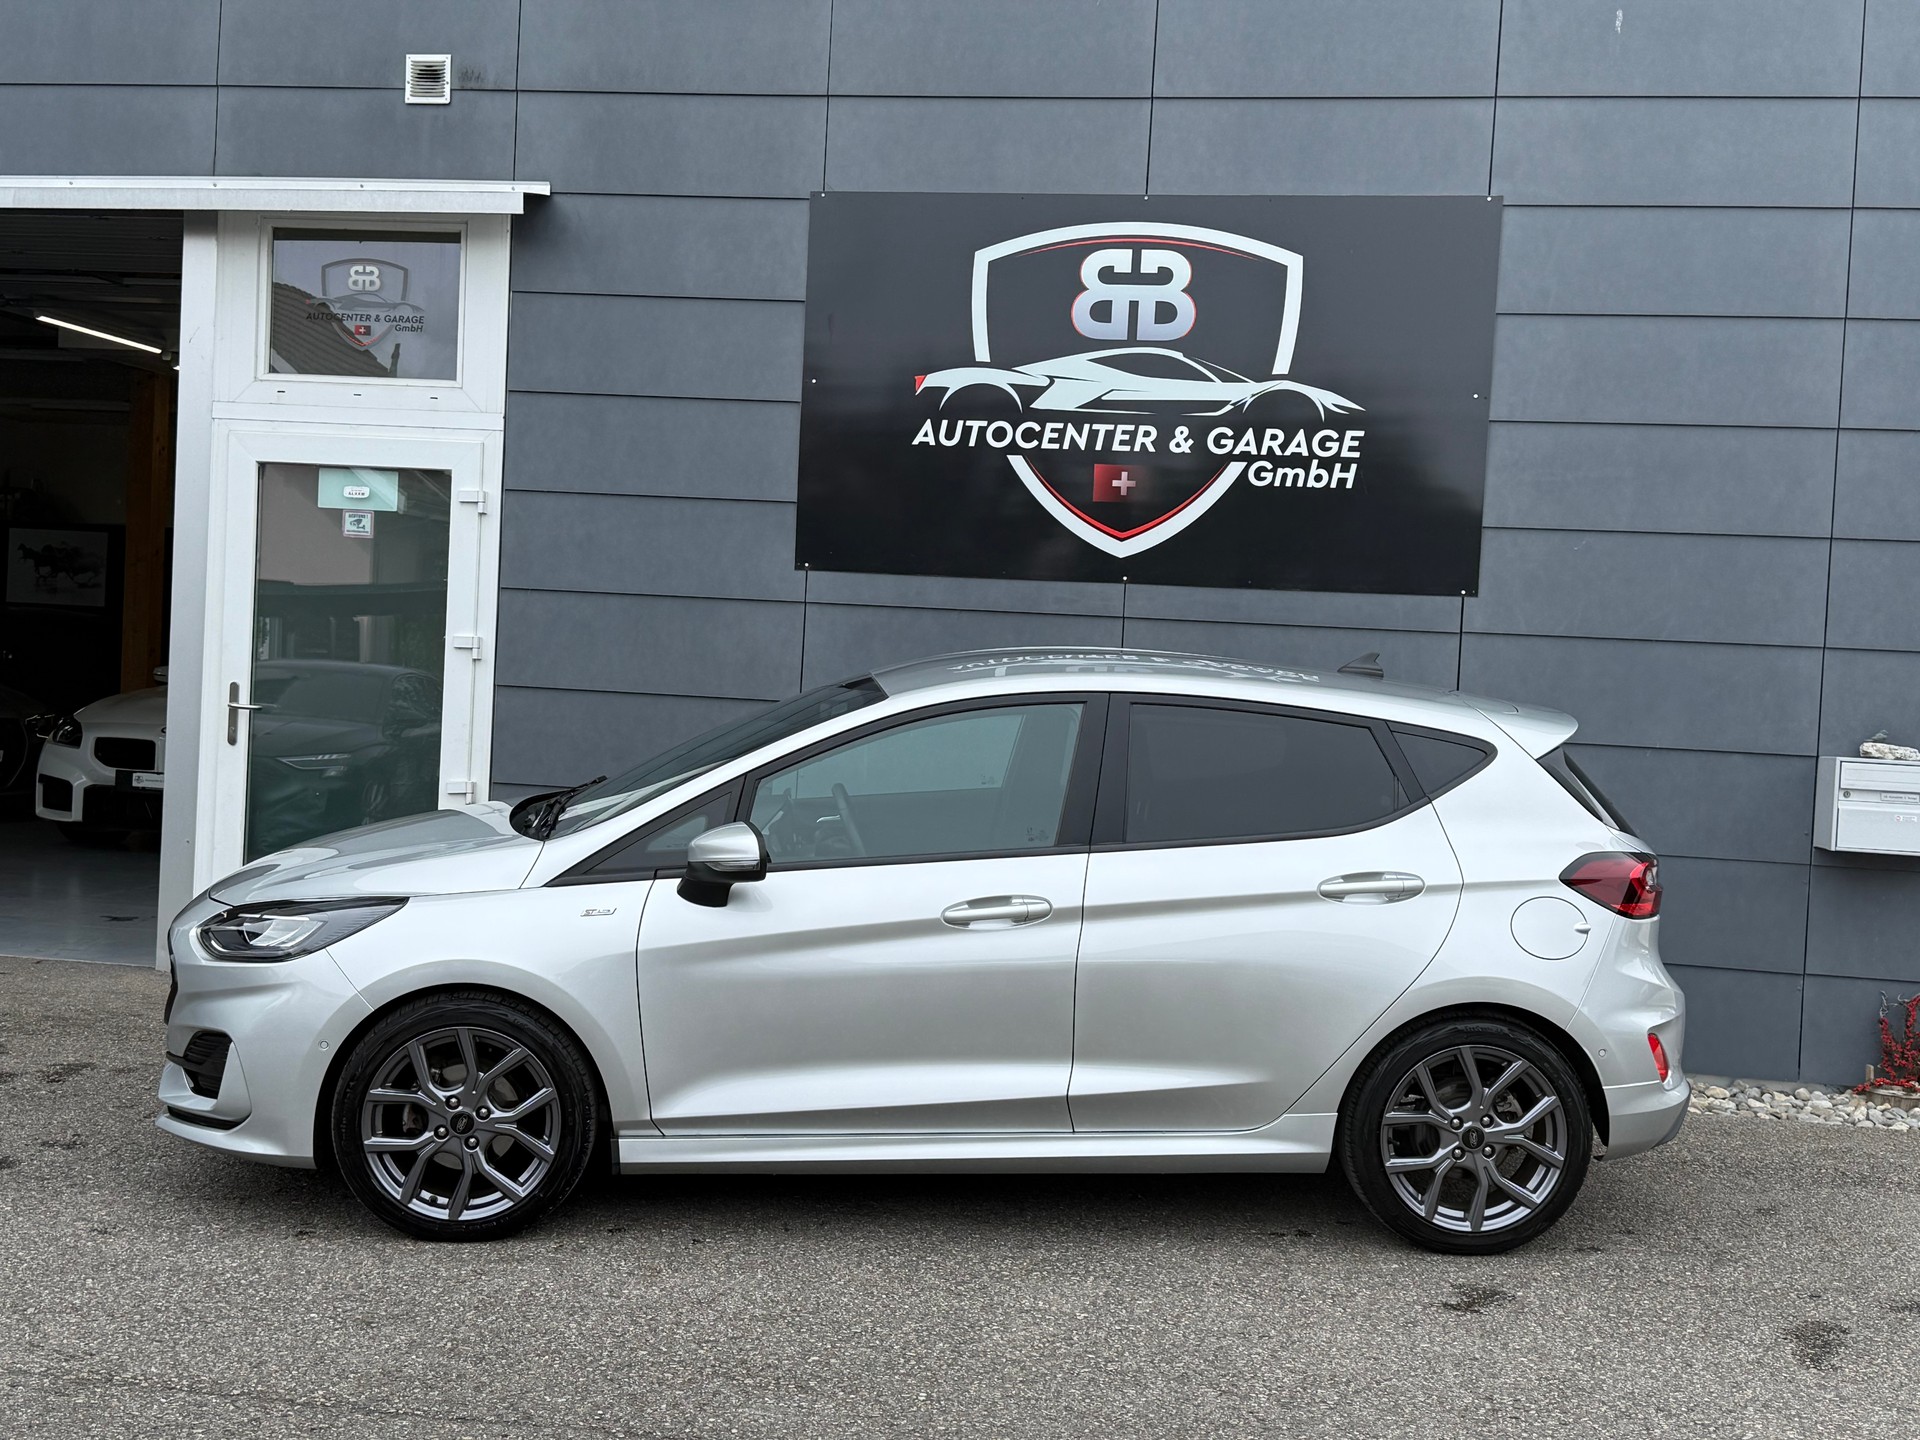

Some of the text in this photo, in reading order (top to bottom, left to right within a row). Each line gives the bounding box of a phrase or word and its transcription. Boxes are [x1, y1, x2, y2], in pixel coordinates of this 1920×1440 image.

[305, 312, 425, 324] AUTOCENTER & GARAGE
[394, 324, 424, 333] GmbH
[911, 418, 1366, 459] AUTOCENTER & GARAGE
[1246, 459, 1358, 489] GmbH
